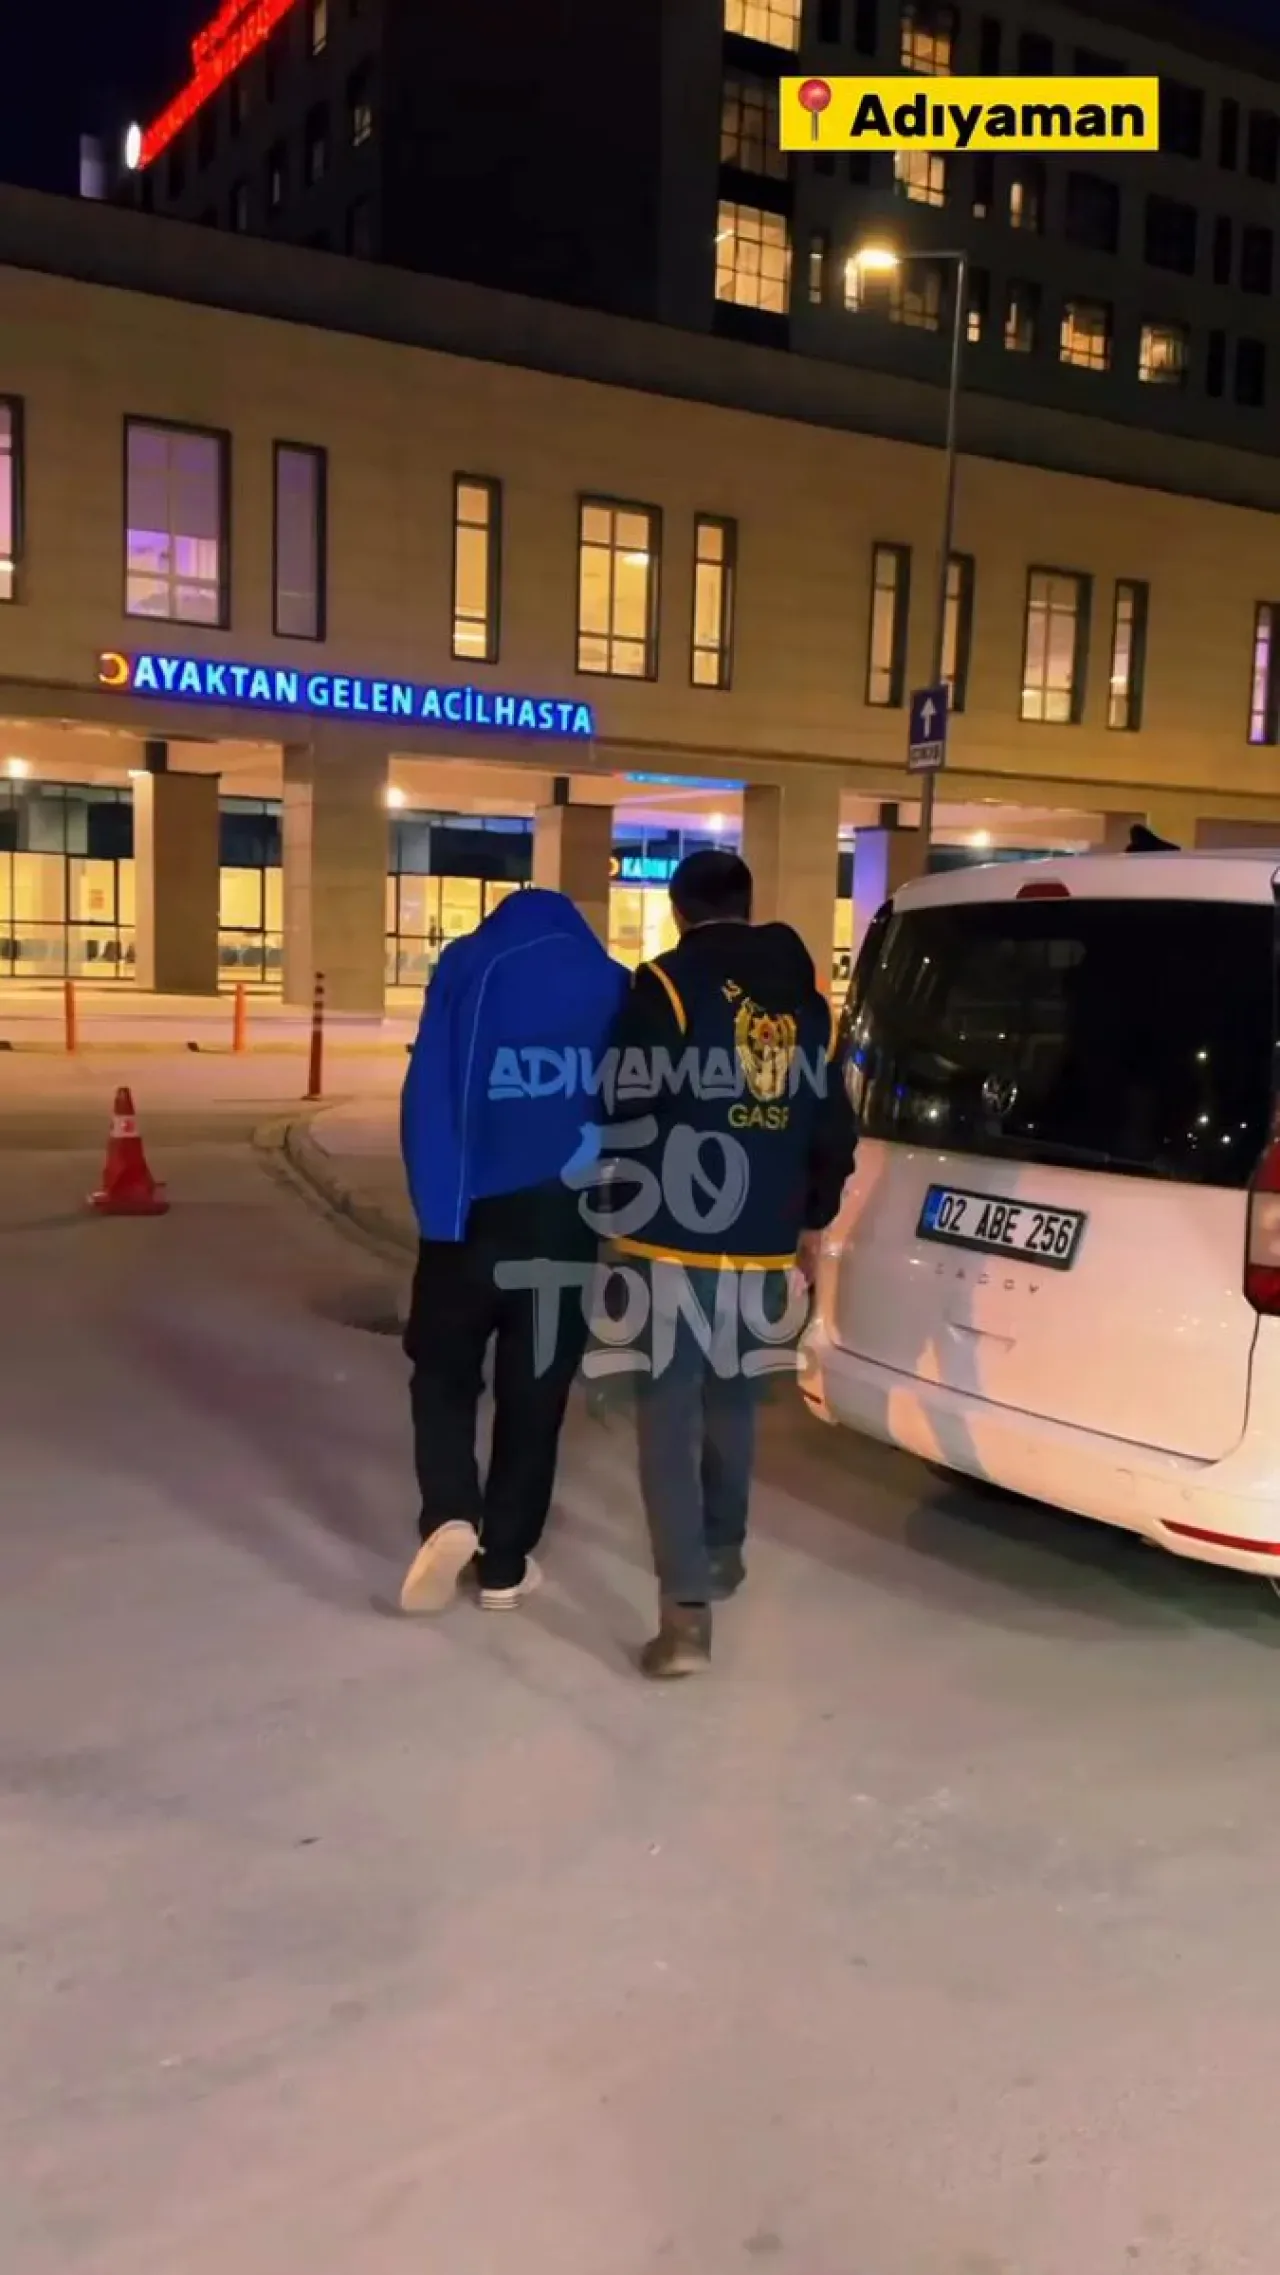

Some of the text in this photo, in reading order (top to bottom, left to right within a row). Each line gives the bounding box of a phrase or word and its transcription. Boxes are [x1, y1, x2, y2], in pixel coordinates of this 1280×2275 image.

[134, 654, 298, 703] AYAKTAN
[306, 675, 412, 716] GELEN
[937, 1196, 1073, 1254] 02 ABE 256
